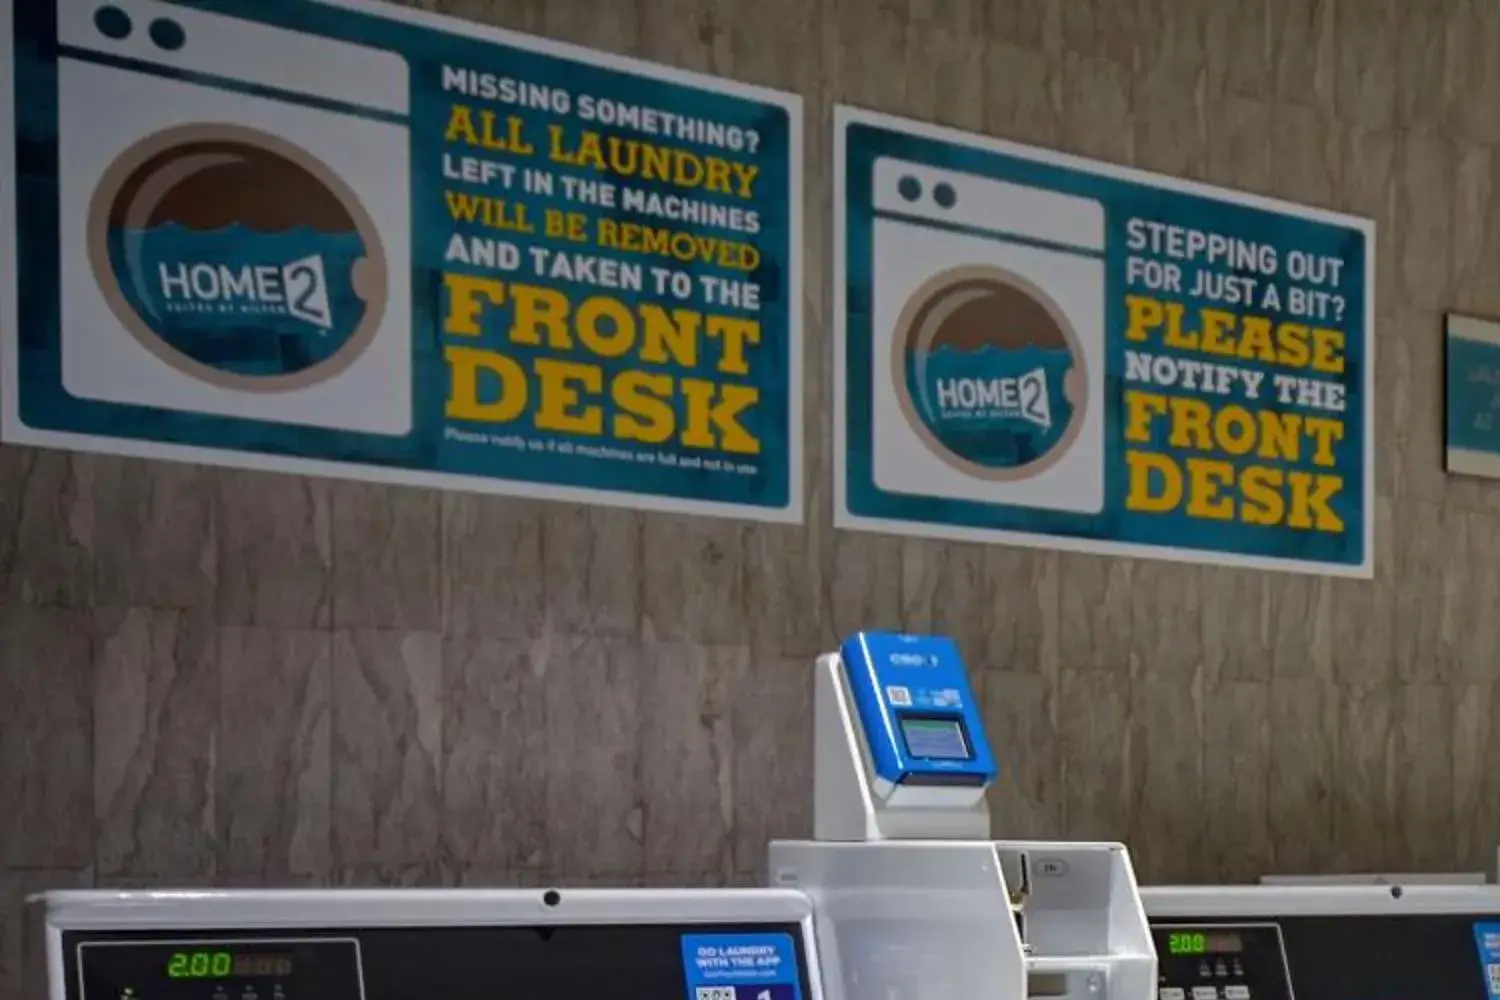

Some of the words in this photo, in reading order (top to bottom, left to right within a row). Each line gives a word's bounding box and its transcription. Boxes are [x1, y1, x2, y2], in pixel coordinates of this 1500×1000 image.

[442, 64, 570, 114] MISSING
[577, 96, 760, 153] SOMETHING?
[444, 104, 534, 155] ALL
[548, 123, 759, 198] LAUNDRY
[443, 152, 516, 189] LEFT
[524, 169, 552, 196] IN
[560, 174, 616, 207] THE
[622, 186, 760, 234] MACHINES
[444, 190, 534, 233] WILL
[545, 208, 588, 242] BE
[597, 217, 760, 271] REMOVED
[445, 233, 520, 271] AND
[529, 246, 642, 291] TAKEN
[651, 266, 691, 298] TO
[700, 275, 760, 310] THE
[1126, 217, 1277, 275] STEPPING
[1287, 251, 1344, 287] OUT
[1127, 256, 1182, 293] FOR
[1189, 270, 1257, 306] JUST
[1261, 283, 1282, 312] A
[1288, 287, 1345, 321] BIT?
[443, 273, 760, 374] FRONT
[1125, 295, 1345, 372] PLEASE
[445, 345, 760, 454] DESK
[1125, 350, 1264, 399] NOTIFY
[1274, 374, 1346, 411] THE
[1125, 390, 1344, 467] FRONT
[1125, 450, 1344, 533] DESK
